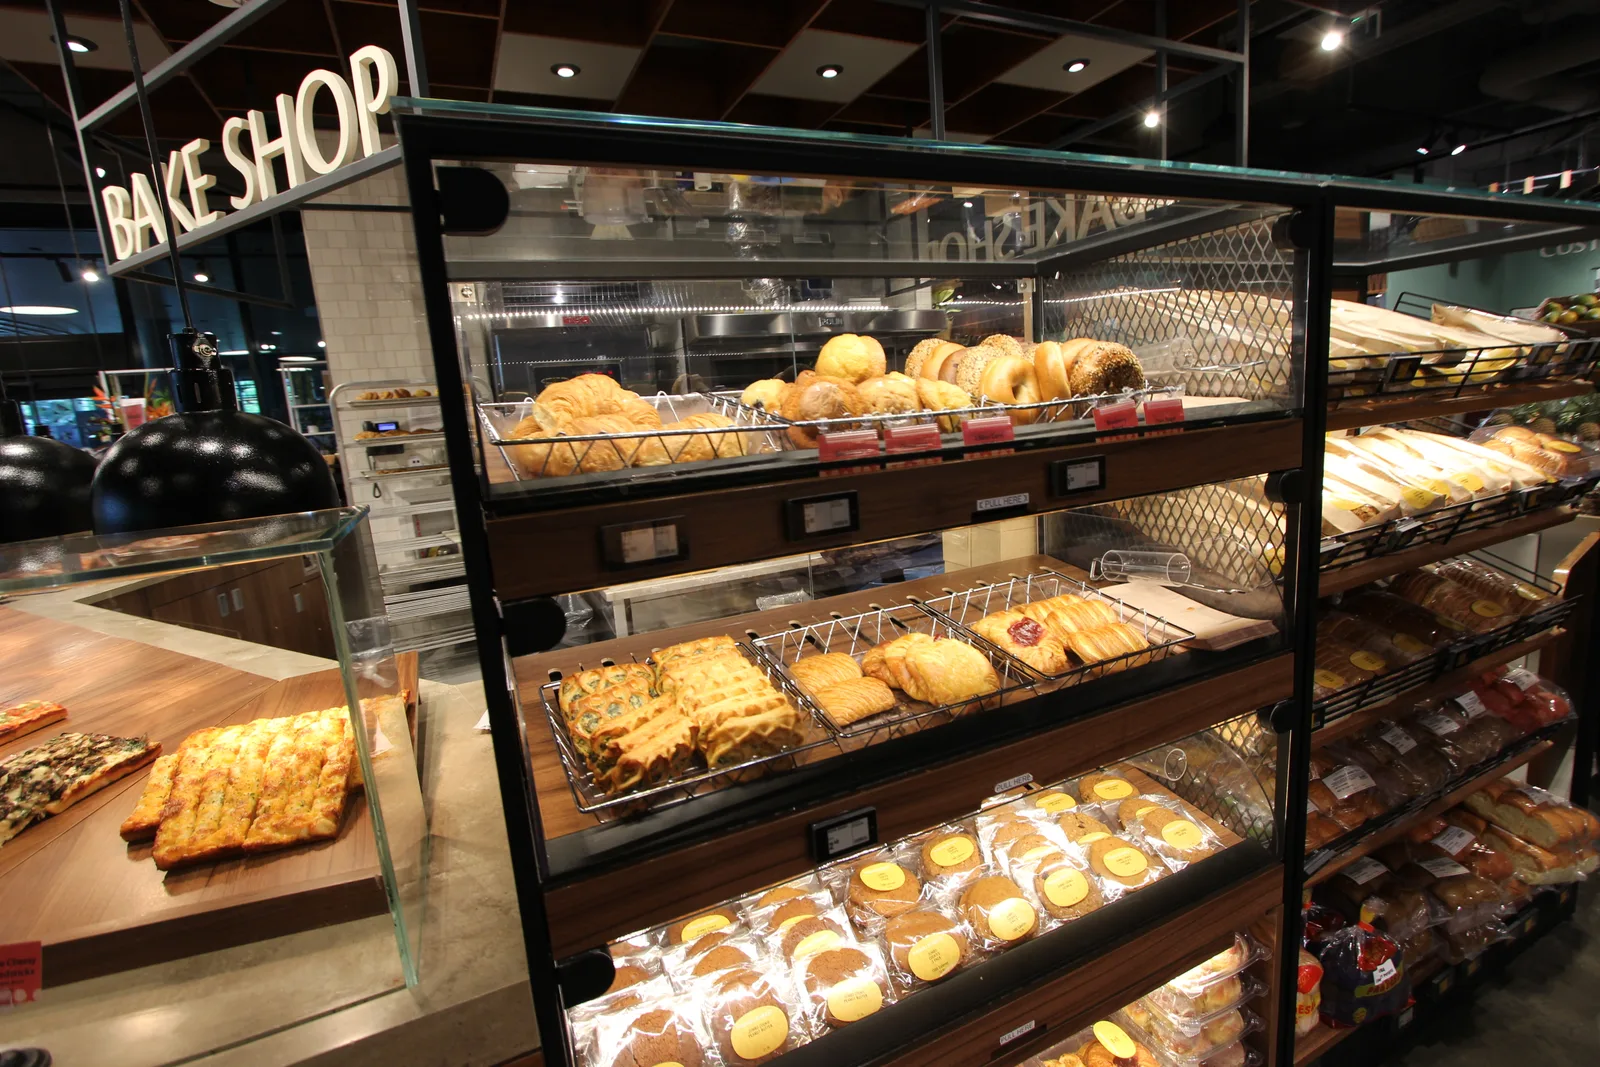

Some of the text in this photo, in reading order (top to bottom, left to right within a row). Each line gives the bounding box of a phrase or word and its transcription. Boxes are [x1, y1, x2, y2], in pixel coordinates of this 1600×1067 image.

[102, 45, 398, 260] BAKE SHOP
[985, 494, 1022, 508] PULL HERE
[996, 774, 1031, 792] PULL HERE
[1001, 1022, 1033, 1044] PULL HERE
